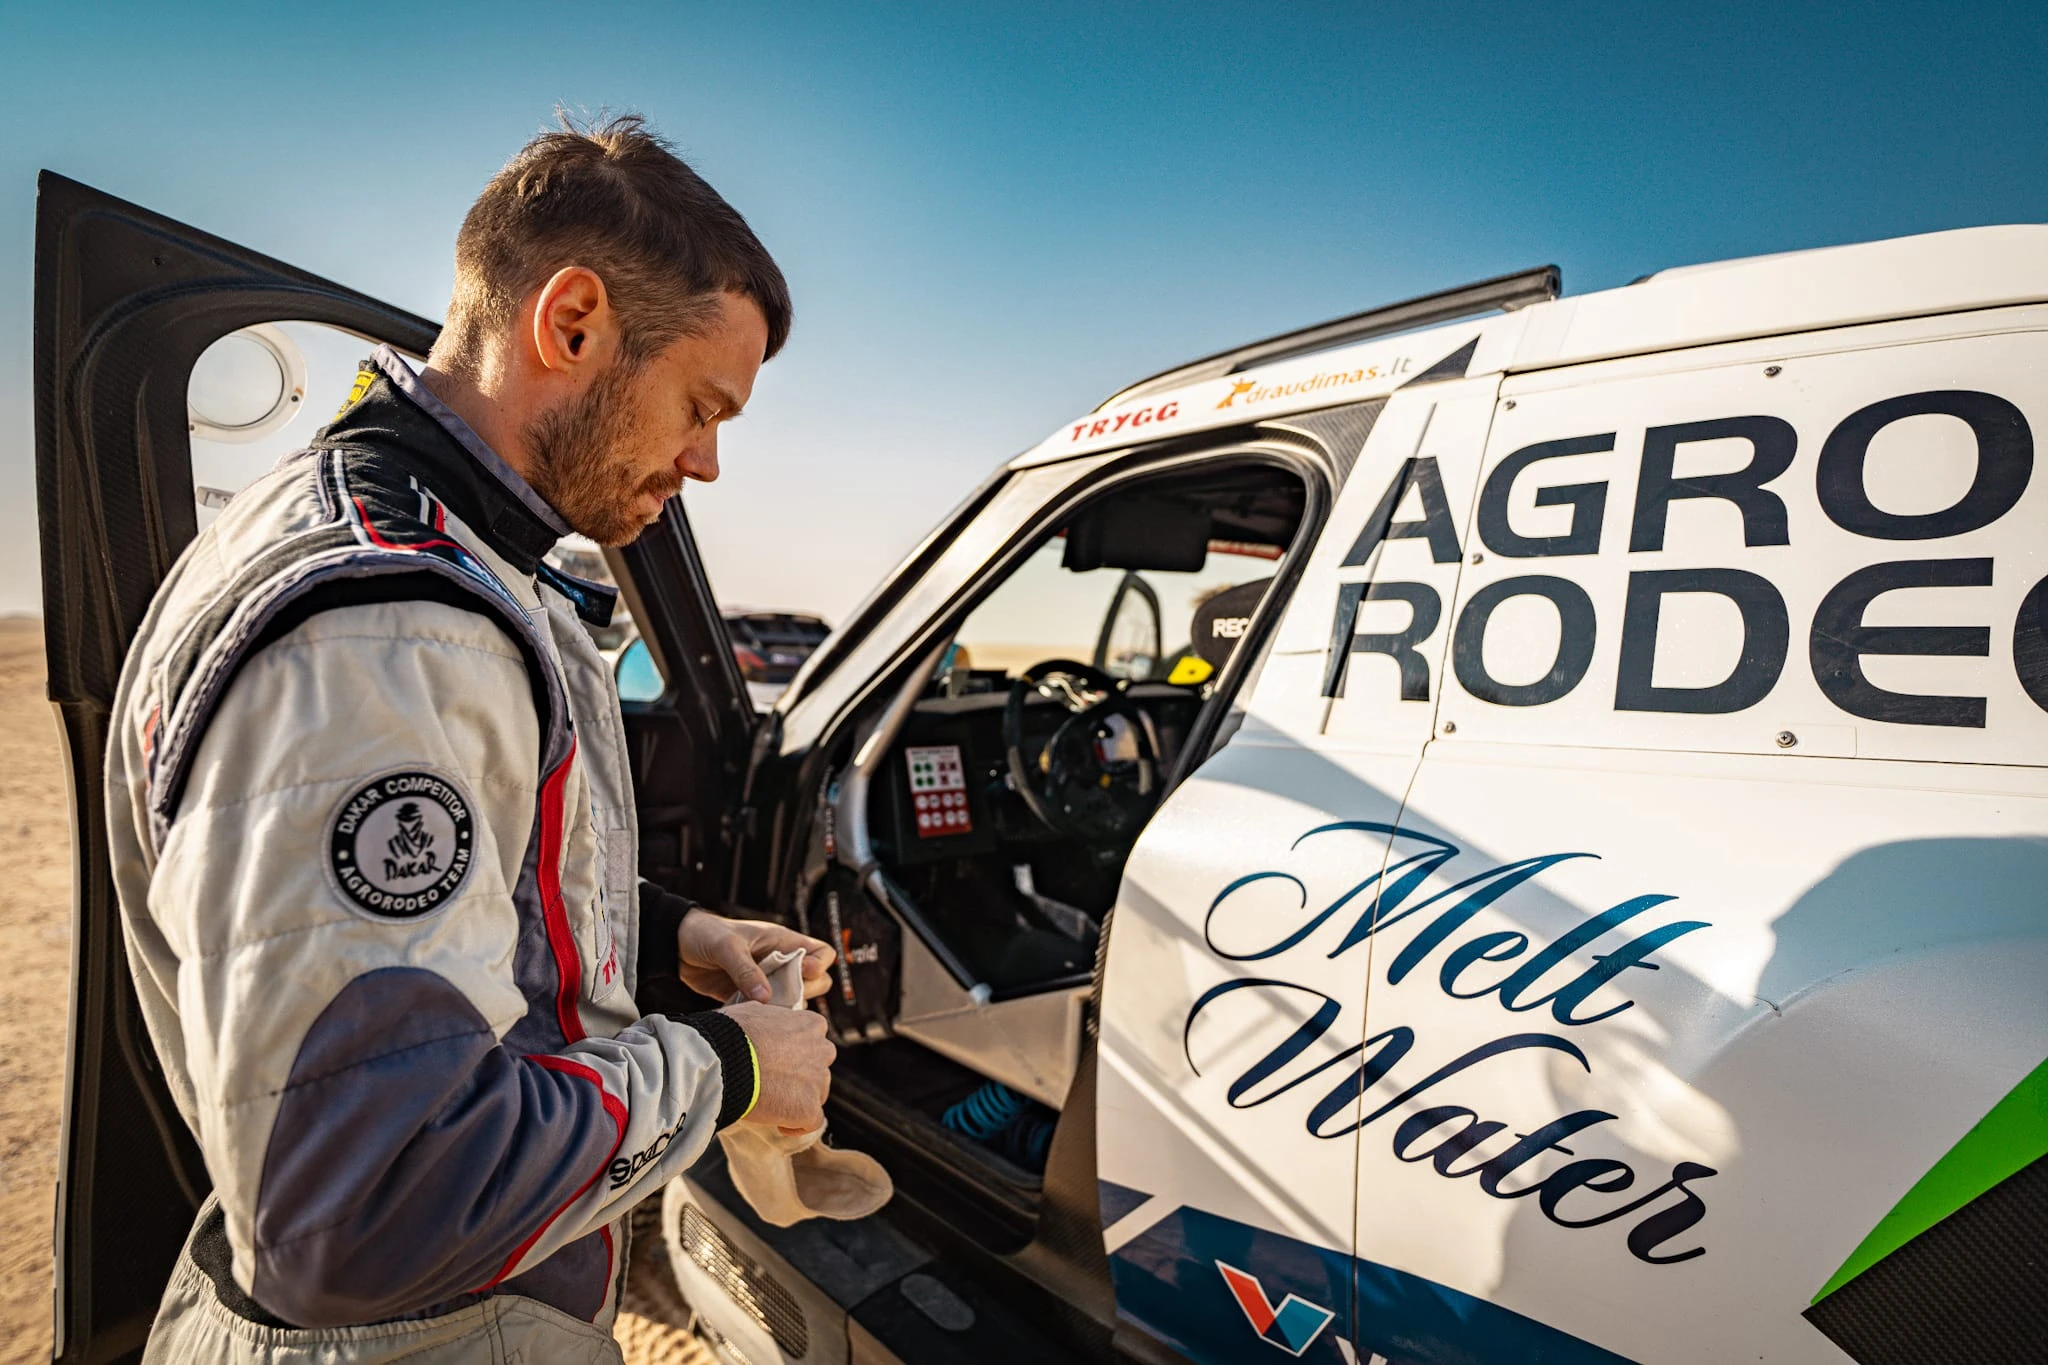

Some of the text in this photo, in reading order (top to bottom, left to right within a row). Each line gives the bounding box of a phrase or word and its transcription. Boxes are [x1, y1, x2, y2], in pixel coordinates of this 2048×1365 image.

[1072, 401, 1179, 442] TRYGG
[1245, 356, 1412, 404] draudimas.lt
[1340, 390, 2034, 567] AGRO
[1321, 557, 2048, 729] RODE
[338, 777, 467, 834] DAKAR COMPETITOR
[340, 848, 470, 911] AGRORODEO TEAM
[1204, 819, 1713, 1026] Melt
[1184, 977, 1719, 1265] Water
